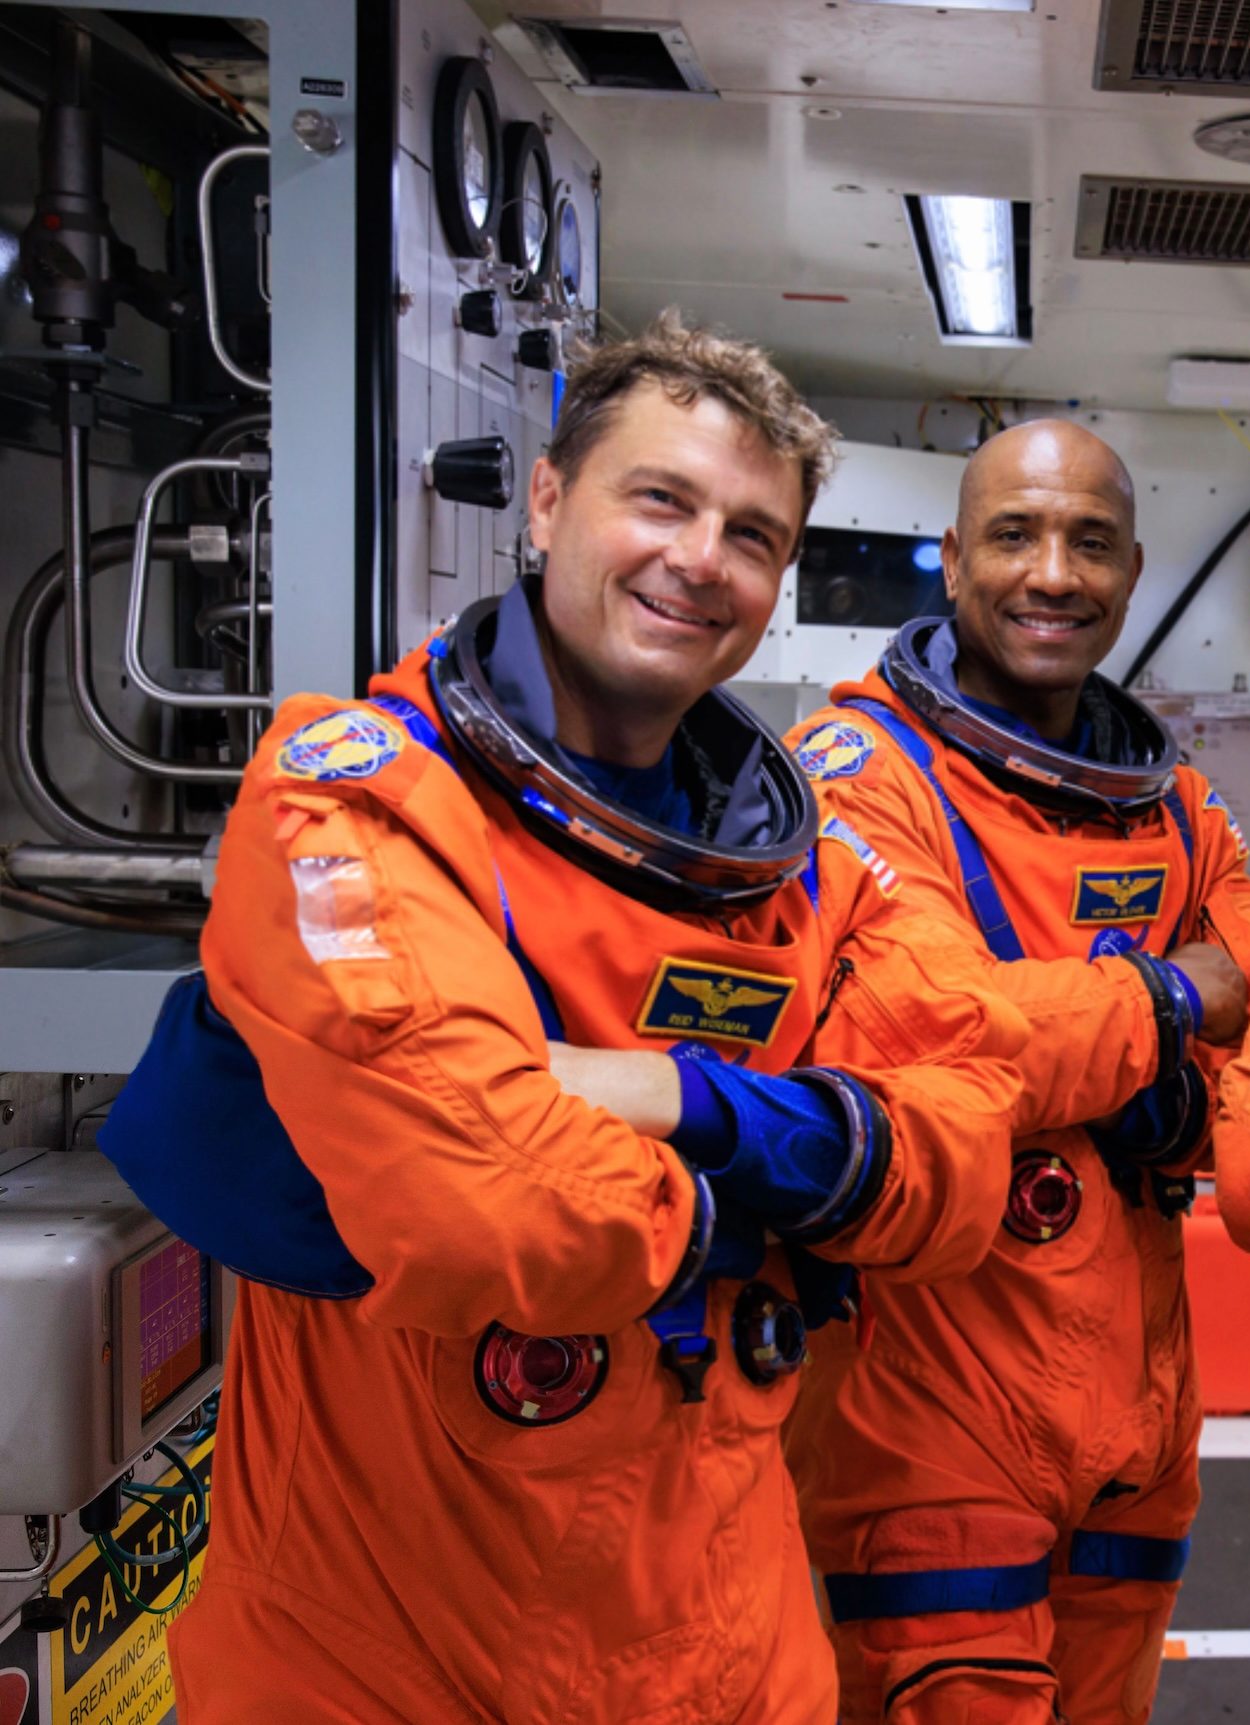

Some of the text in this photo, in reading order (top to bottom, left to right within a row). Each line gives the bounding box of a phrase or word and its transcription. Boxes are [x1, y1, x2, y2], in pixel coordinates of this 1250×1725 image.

[698, 1017, 750, 1034] WISEMAN
[70, 1634, 146, 1725] BREATHING
[148, 1612, 167, 1648] AIR
[116, 1651, 166, 1722] ANALYZER
